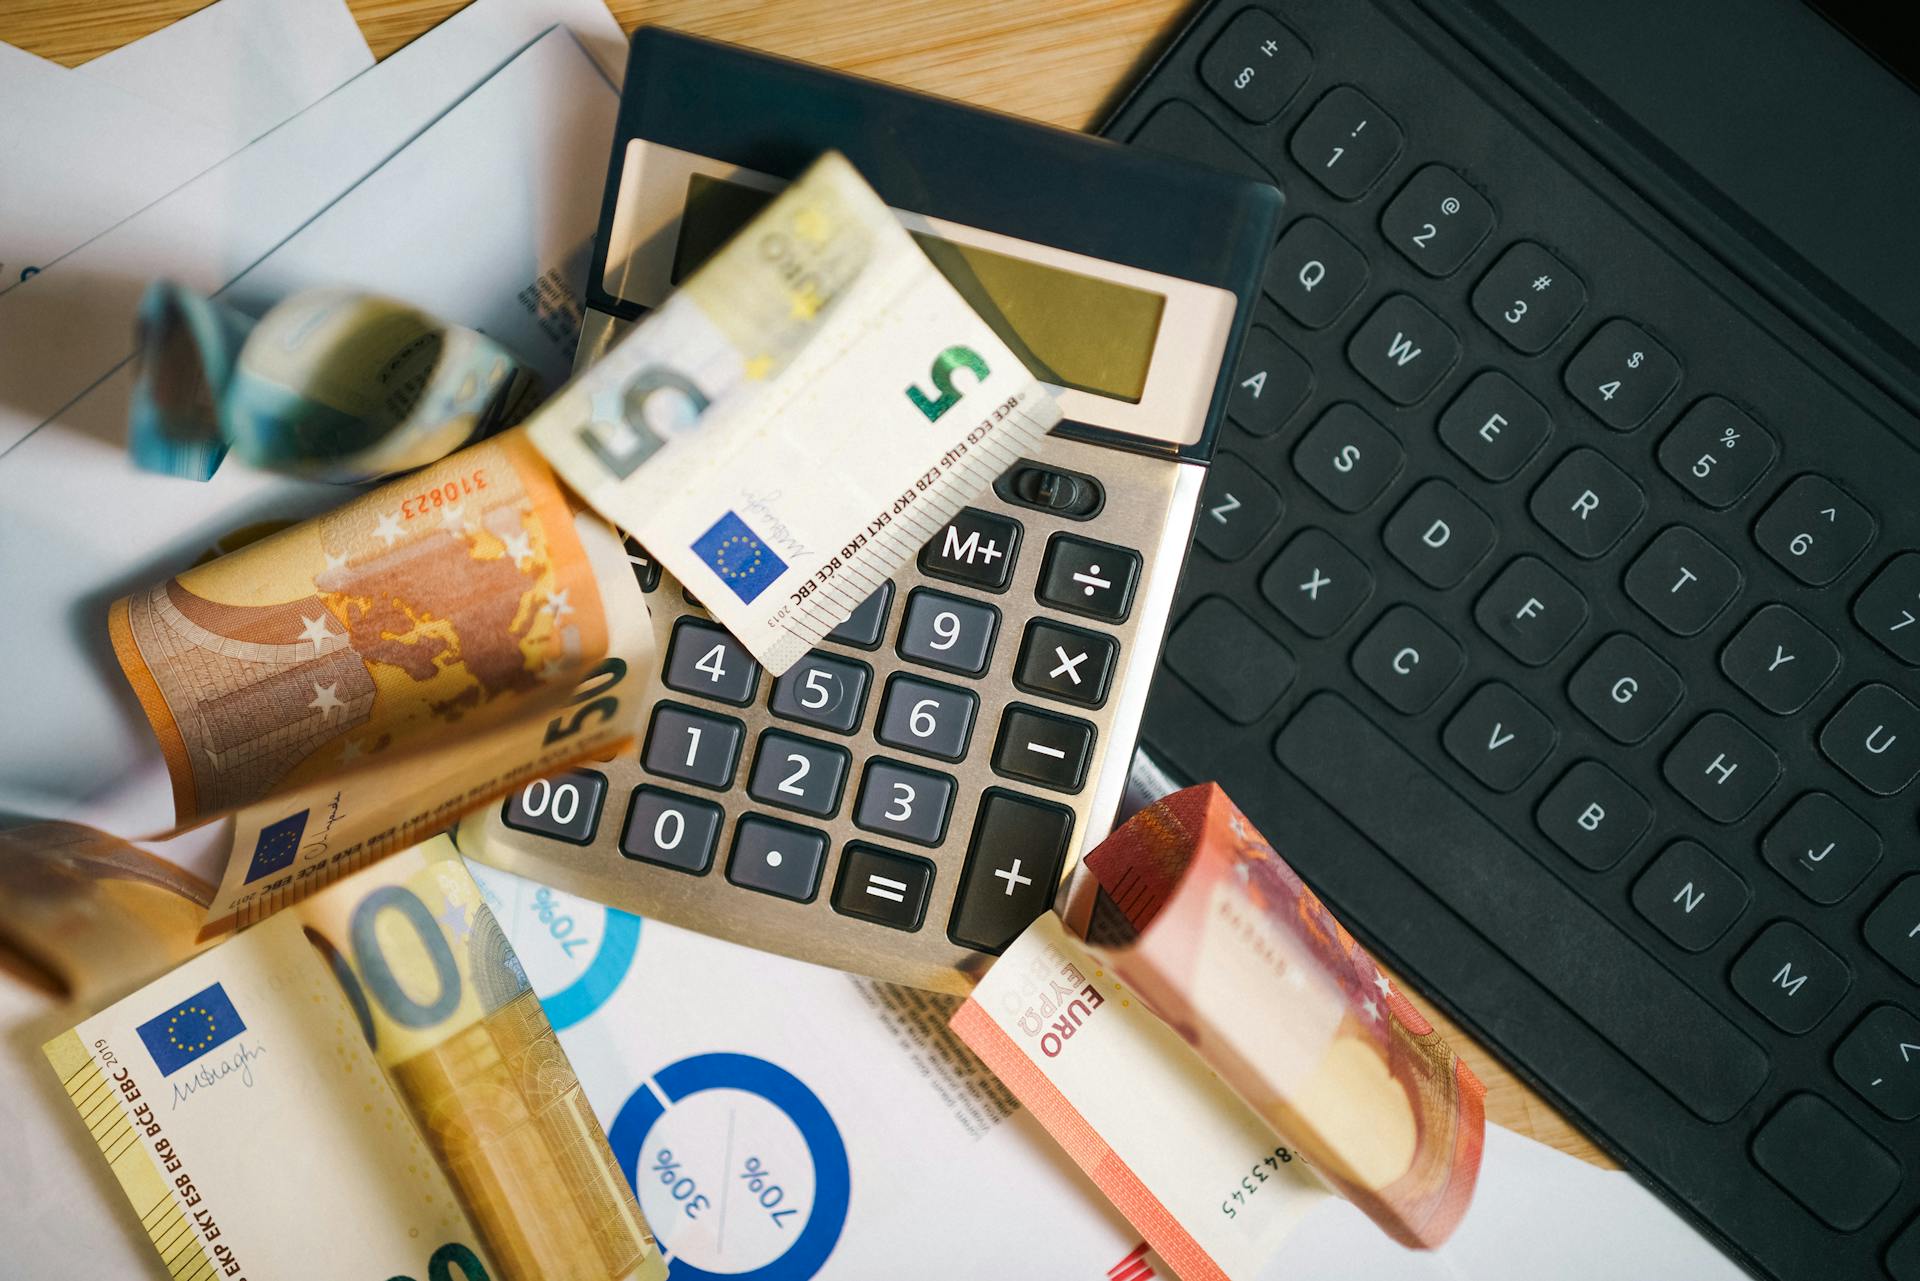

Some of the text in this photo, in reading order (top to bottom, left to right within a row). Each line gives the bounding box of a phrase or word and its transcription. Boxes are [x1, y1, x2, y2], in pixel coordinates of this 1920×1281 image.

[1351, 120, 1368, 138] !
[1327, 147, 1345, 168] 1
[1441, 197, 1461, 216] @
[1412, 223, 1437, 249] 2
[1299, 260, 1326, 292] Q
[1532, 275, 1552, 292] #
[1504, 300, 1528, 324] 3
[1387, 331, 1422, 367] W
[1627, 351, 1644, 369] $
[906, 345, 991, 424] 5
[1241, 371, 1268, 399] A
[1598, 380, 1622, 401] 4
[577, 364, 712, 481] 5
[993, 395, 1019, 422] BCE
[967, 420, 993, 446] ECB
[1479, 413, 1508, 443] E
[1719, 427, 1742, 449] %
[1333, 445, 1361, 472] S
[1692, 453, 1717, 478] 5
[916, 466, 943, 491] EZB
[402, 469, 487, 520] 310823
[893, 489, 918, 515] EKP
[1211, 493, 1241, 524] Z
[1571, 489, 1600, 520] R
[868, 512, 893, 538] EKT
[1422, 519, 1451, 548] D
[841, 534, 868, 560] EKB
[942, 525, 1002, 565] M+
[1789, 533, 1814, 556] 6
[789, 580, 818, 606] EBC
[1300, 567, 1331, 600] X
[1671, 567, 1697, 593] T
[766, 604, 791, 629] 2013
[1516, 597, 1545, 619] F
[1889, 609, 1916, 631] 7
[929, 612, 961, 650] 9
[695, 644, 726, 682] 4
[1393, 647, 1420, 675] C
[1768, 645, 1795, 672] Y
[542, 656, 628, 747] 50
[801, 669, 833, 709] 5
[1611, 677, 1638, 704] G
[909, 699, 940, 738] 6
[686, 727, 703, 767] 1
[1488, 722, 1515, 750] V
[1865, 725, 1897, 754] U
[778, 754, 810, 796] 2
[1705, 753, 1738, 785] H
[521, 777, 580, 825] 00
[884, 782, 916, 821] 3
[654, 809, 685, 850] 0
[1577, 802, 1605, 831] B
[1808, 842, 1835, 862] J
[261, 873, 293, 895] EBC
[866, 874, 907, 903] =
[994, 858, 1032, 896] +
[1673, 882, 1705, 913] N
[528, 886, 589, 960] 70%
[1772, 962, 1808, 996] M
[1040, 984, 1105, 1058] EURO
[94, 1038, 118, 1069] 2019
[113, 1066, 142, 1104] EBC
[154, 1137, 183, 1174] EKB
[175, 1173, 202, 1208] ESB
[652, 1148, 711, 1221] 30%
[739, 1156, 799, 1230] 70%
[1222, 1146, 1308, 1220] 843345
[193, 1208, 222, 1243] EKT
[213, 1243, 241, 1278] EKP
